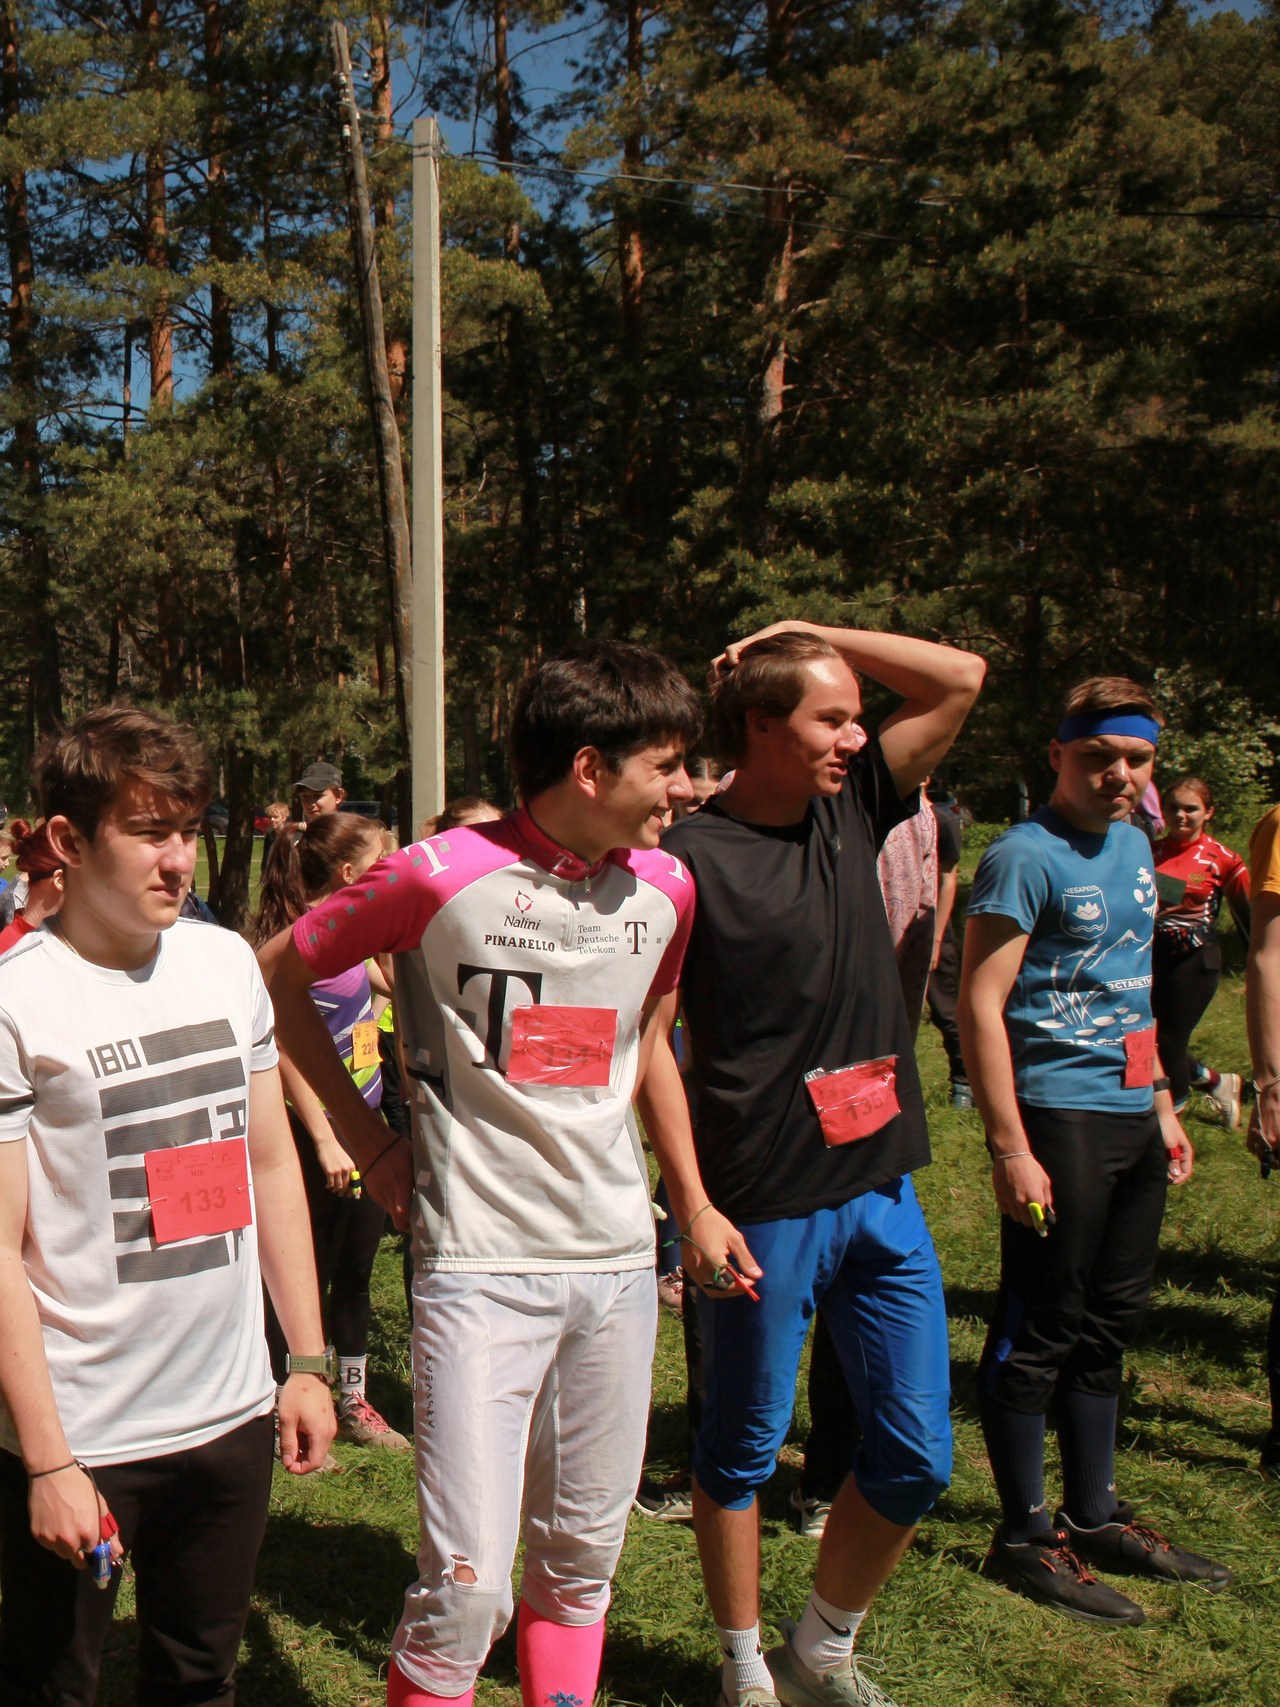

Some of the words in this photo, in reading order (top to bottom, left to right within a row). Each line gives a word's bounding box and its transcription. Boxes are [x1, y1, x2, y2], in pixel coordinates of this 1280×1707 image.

[503, 914, 542, 931] Nalini
[577, 923, 601, 934] Team
[484, 934, 556, 953] PINARELLO
[577, 933, 620, 945] Deutsche
[576, 945, 616, 955] Telekom
[86, 1038, 142, 1079] 180
[845, 1090, 884, 1121] 135
[180, 1185, 227, 1215] 133
